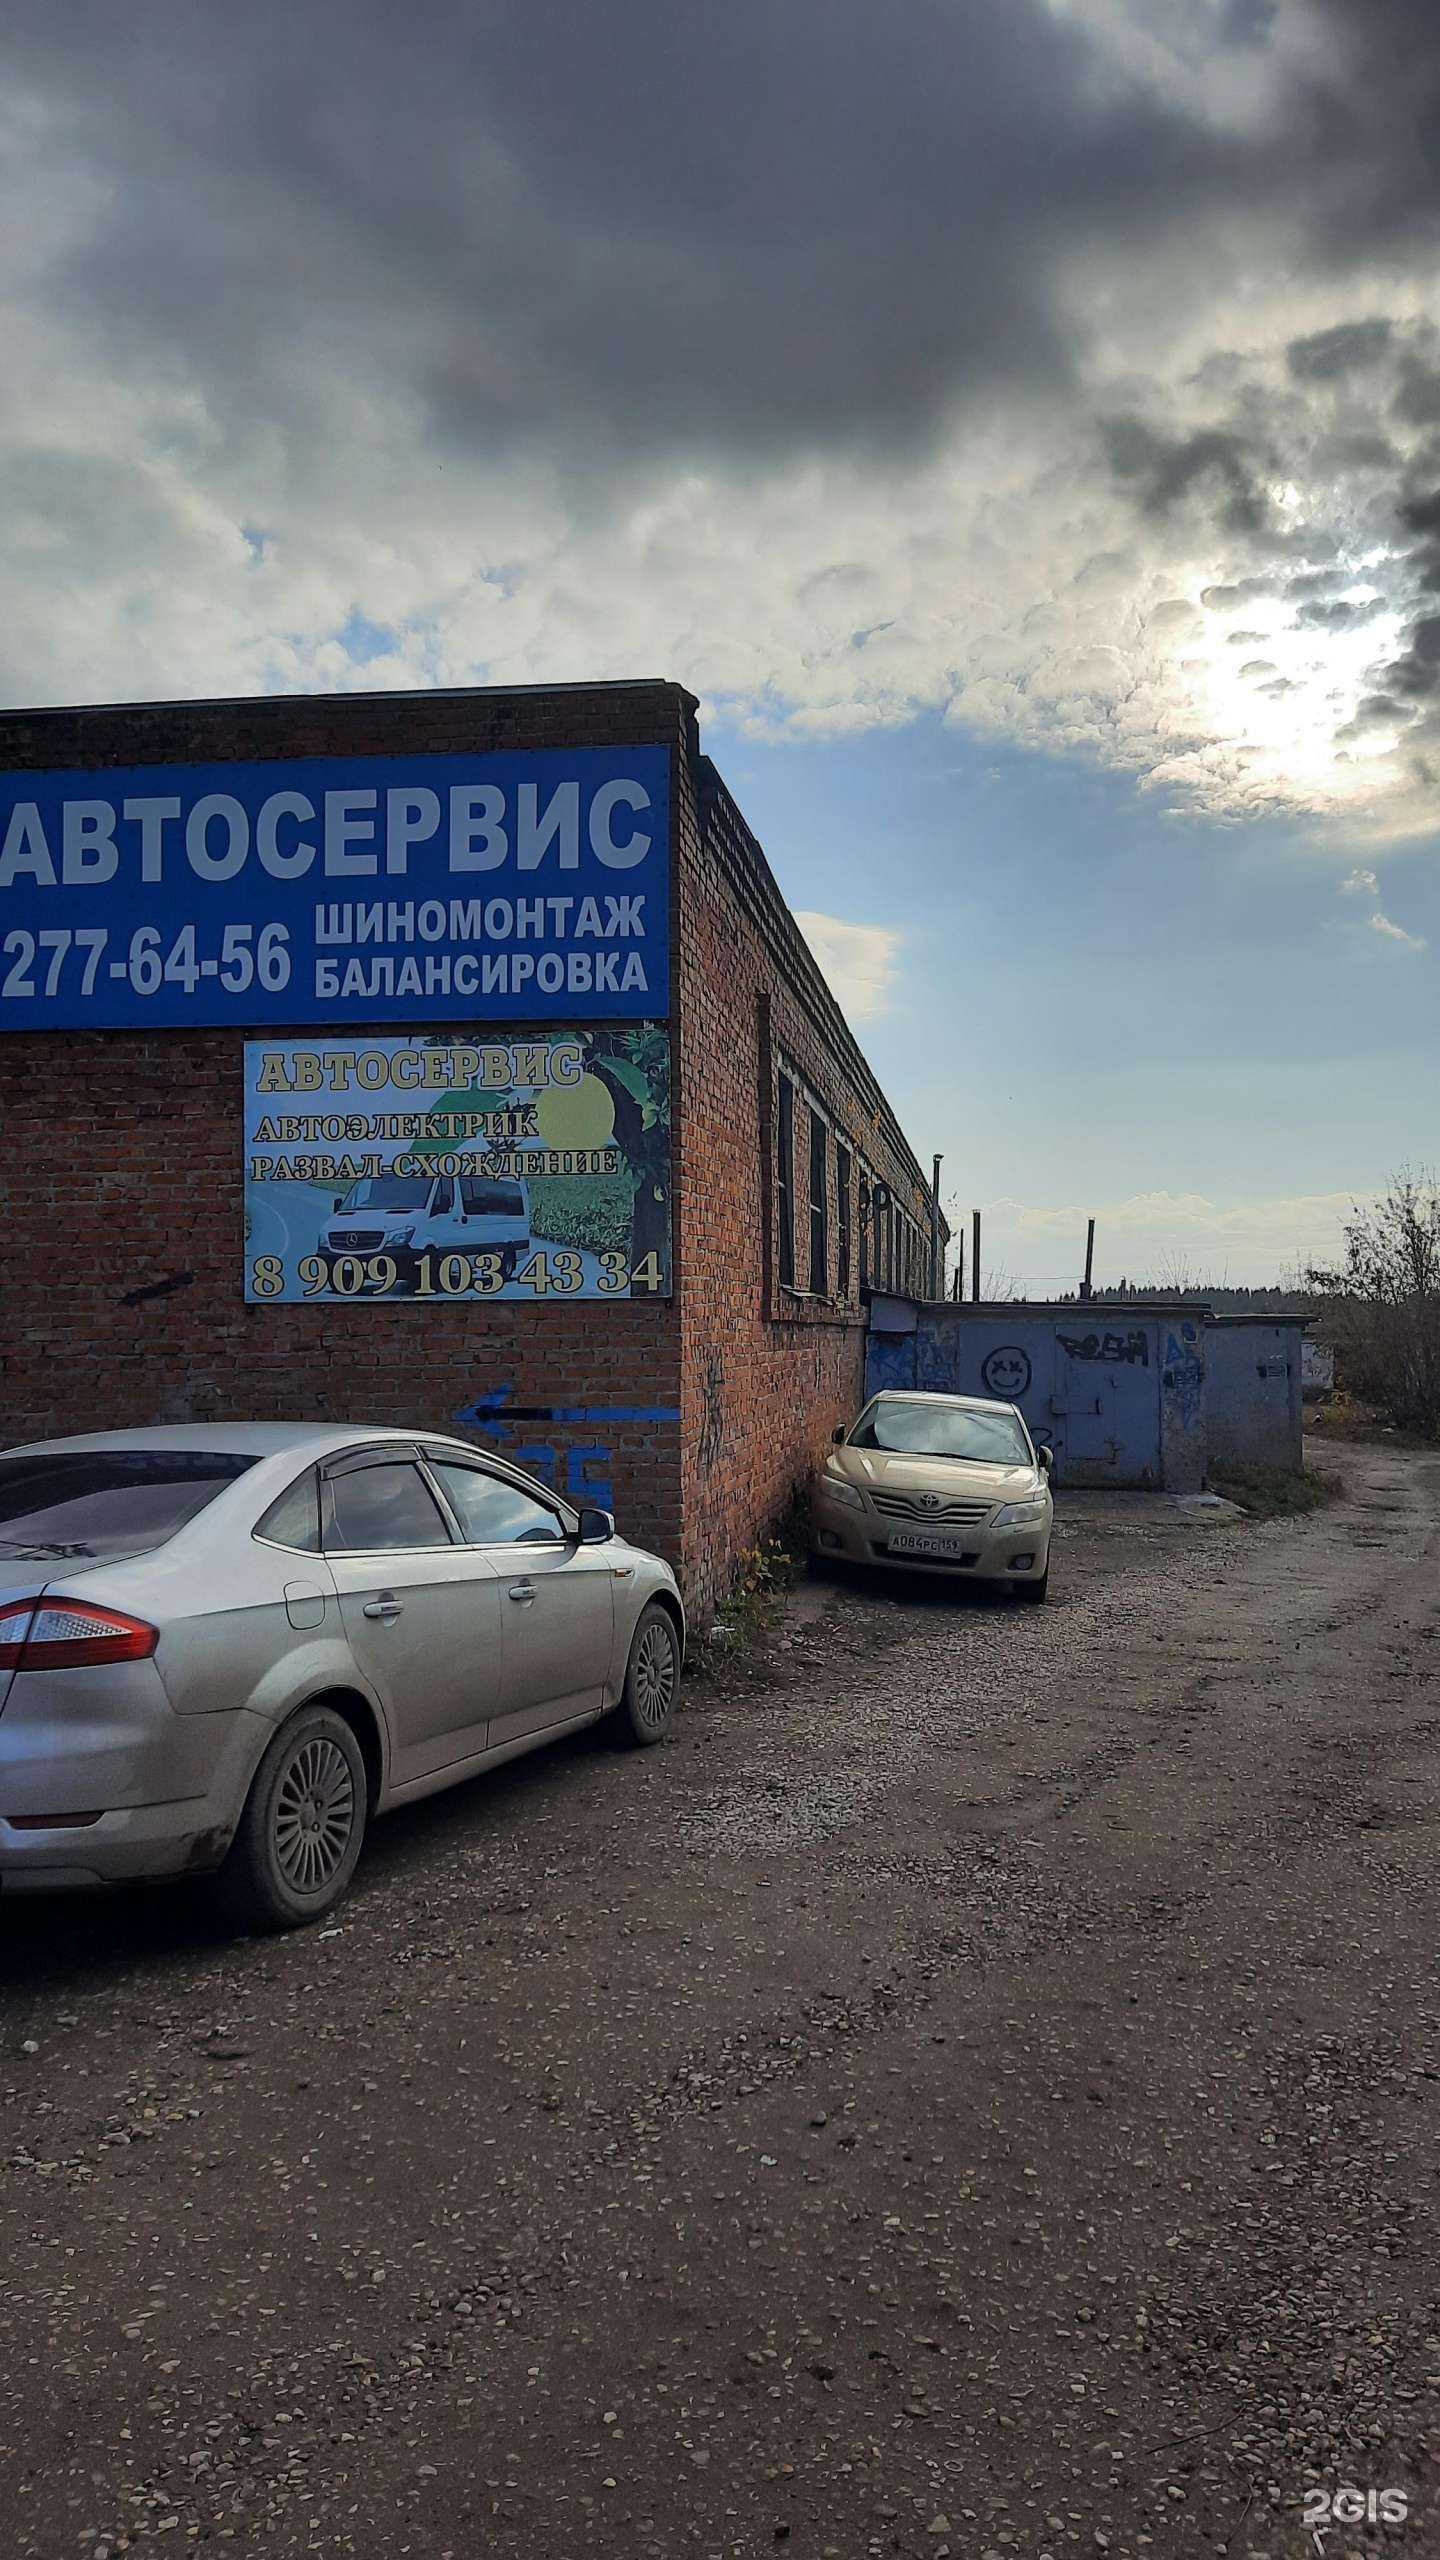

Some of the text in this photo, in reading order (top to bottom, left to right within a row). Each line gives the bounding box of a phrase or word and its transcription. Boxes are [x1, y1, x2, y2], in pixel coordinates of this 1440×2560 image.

[0, 778, 652, 887] АВТОСЕРВИС
[315, 895, 646, 945] ШИНОМОНТАЖ
[1, 922, 291, 998] 277-64-56
[315, 952, 649, 998] БАЛАНСИРОВКА
[255, 1046, 584, 1093] АВТОСЕРВИС
[253, 1110, 540, 1143] АВТОЭЛЕКТРИК
[250, 1149, 619, 1181] РАЗВАЛ-СХОЖДЕНИЕ
[252, 1250, 664, 1297] 8 909 103 43 34
